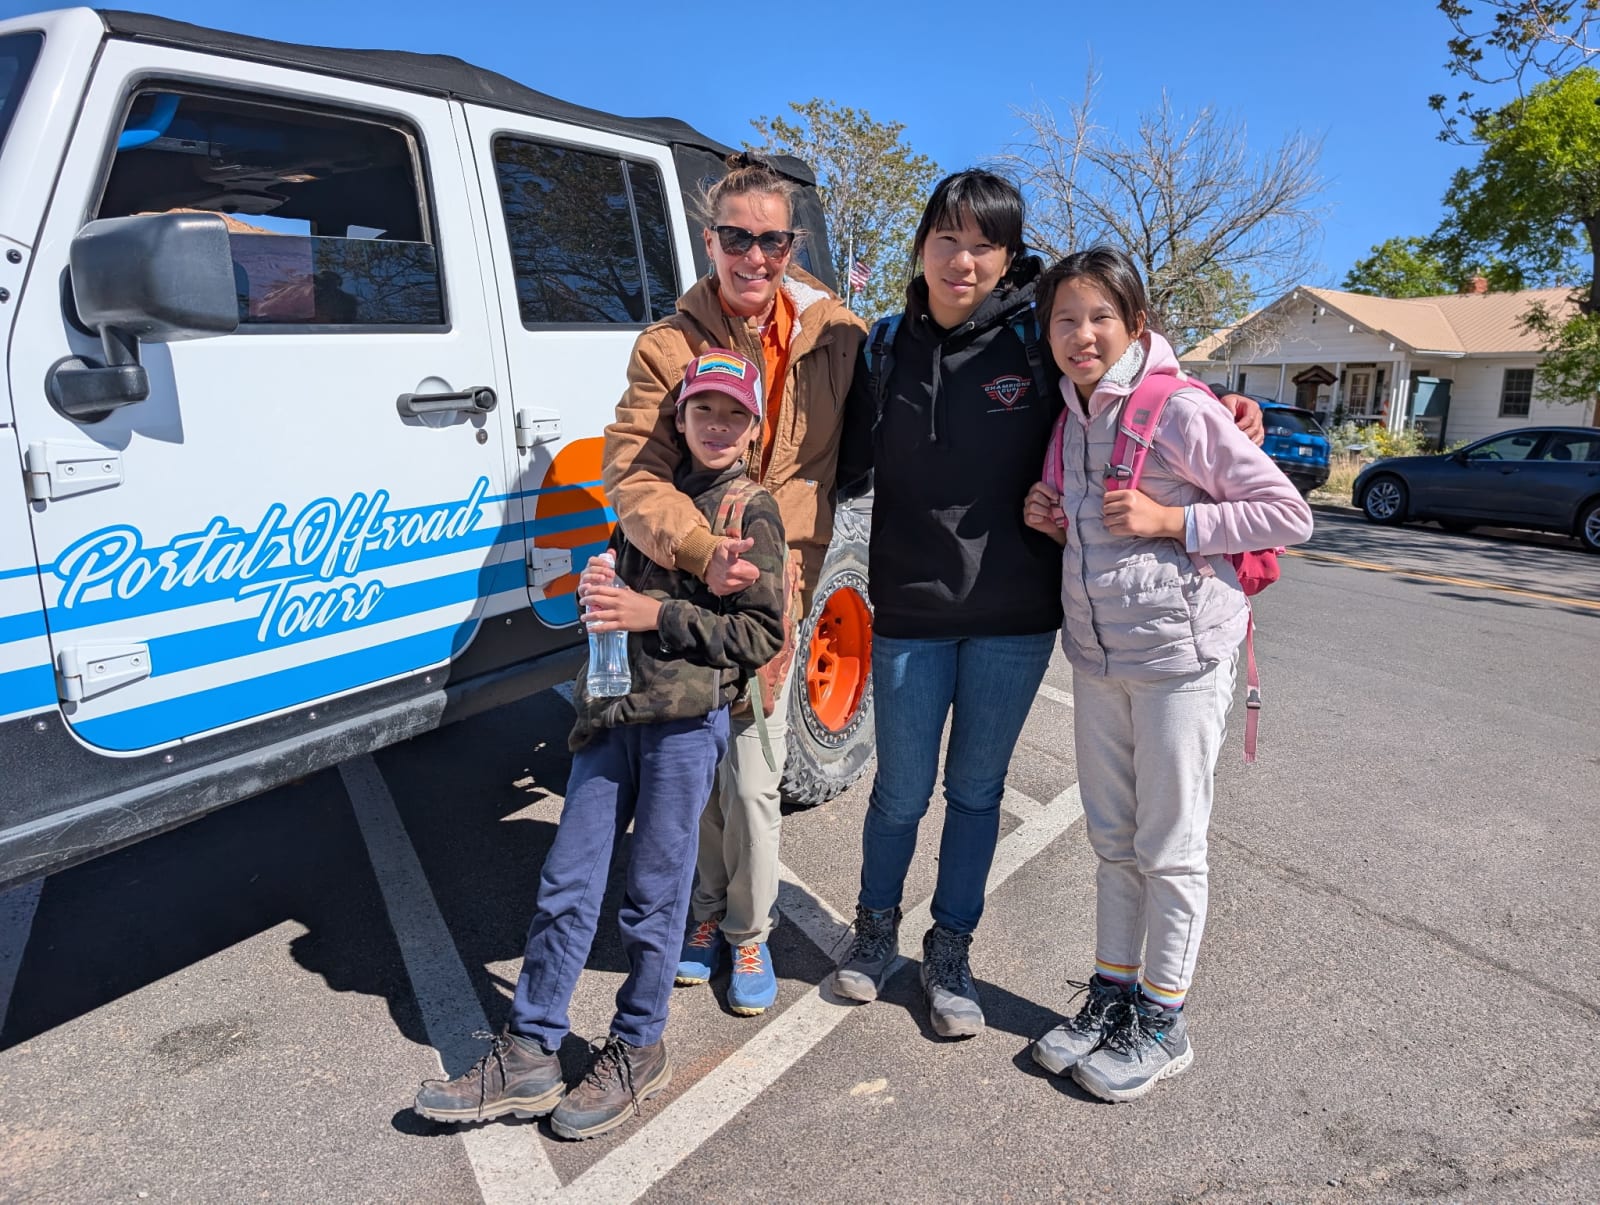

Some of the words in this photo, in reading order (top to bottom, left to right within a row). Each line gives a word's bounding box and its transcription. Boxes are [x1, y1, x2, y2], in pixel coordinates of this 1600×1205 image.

[58, 507, 284, 610] Portal
[293, 479, 488, 579] Offroad
[238, 573, 385, 643] Tours
